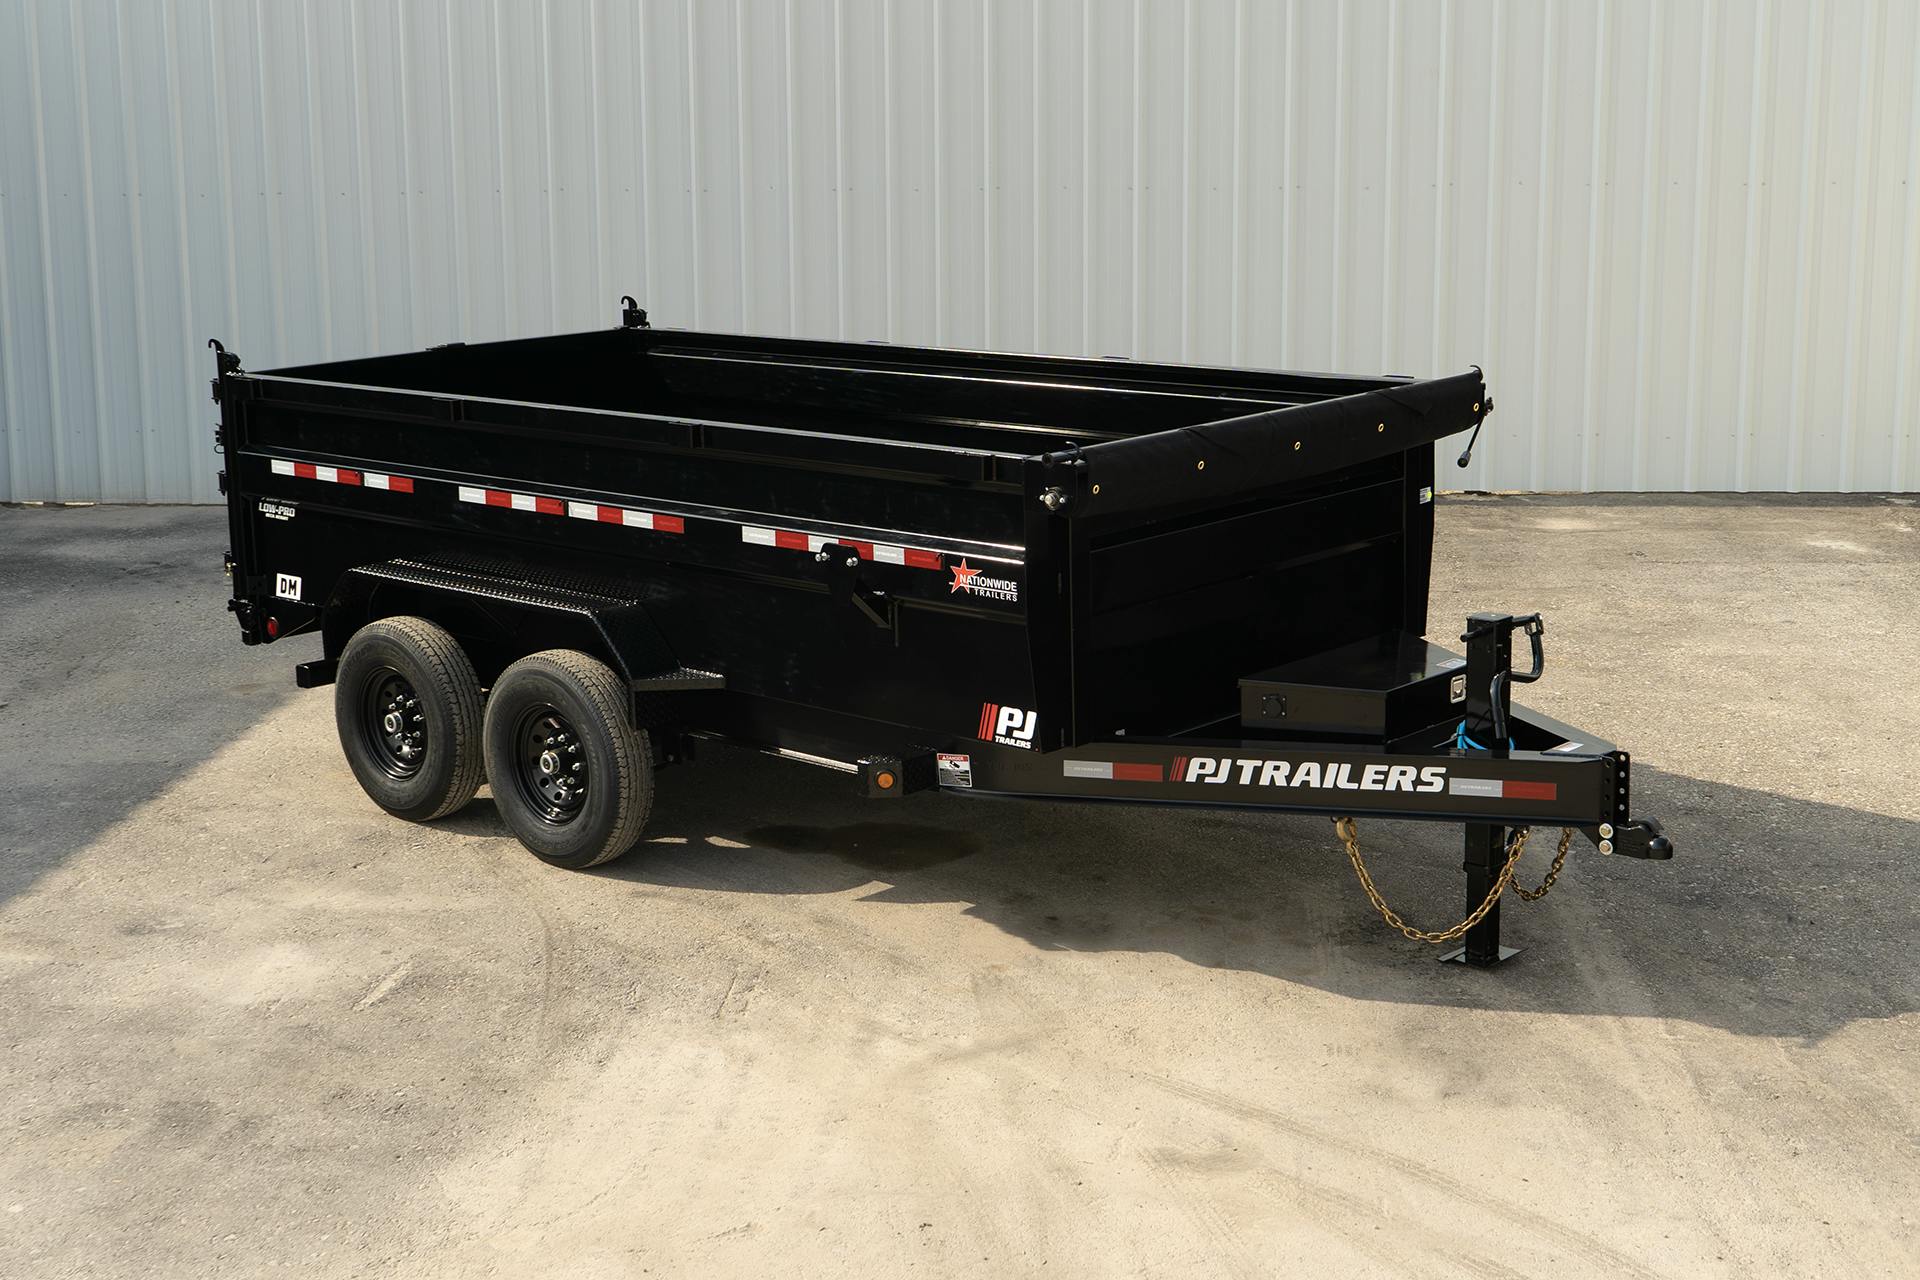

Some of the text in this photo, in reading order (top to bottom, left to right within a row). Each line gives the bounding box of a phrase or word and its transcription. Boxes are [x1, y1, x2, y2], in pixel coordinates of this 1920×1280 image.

[259, 502, 296, 517] LOW-PRO
[280, 577, 297, 596] DM
[960, 573, 1018, 592] NATIONWIDE
[974, 588, 1018, 602] TRAILERS
[996, 706, 1037, 740] PJ
[995, 735, 1031, 749] TRAILERS
[1185, 757, 1447, 792] PJ TRAILERS
